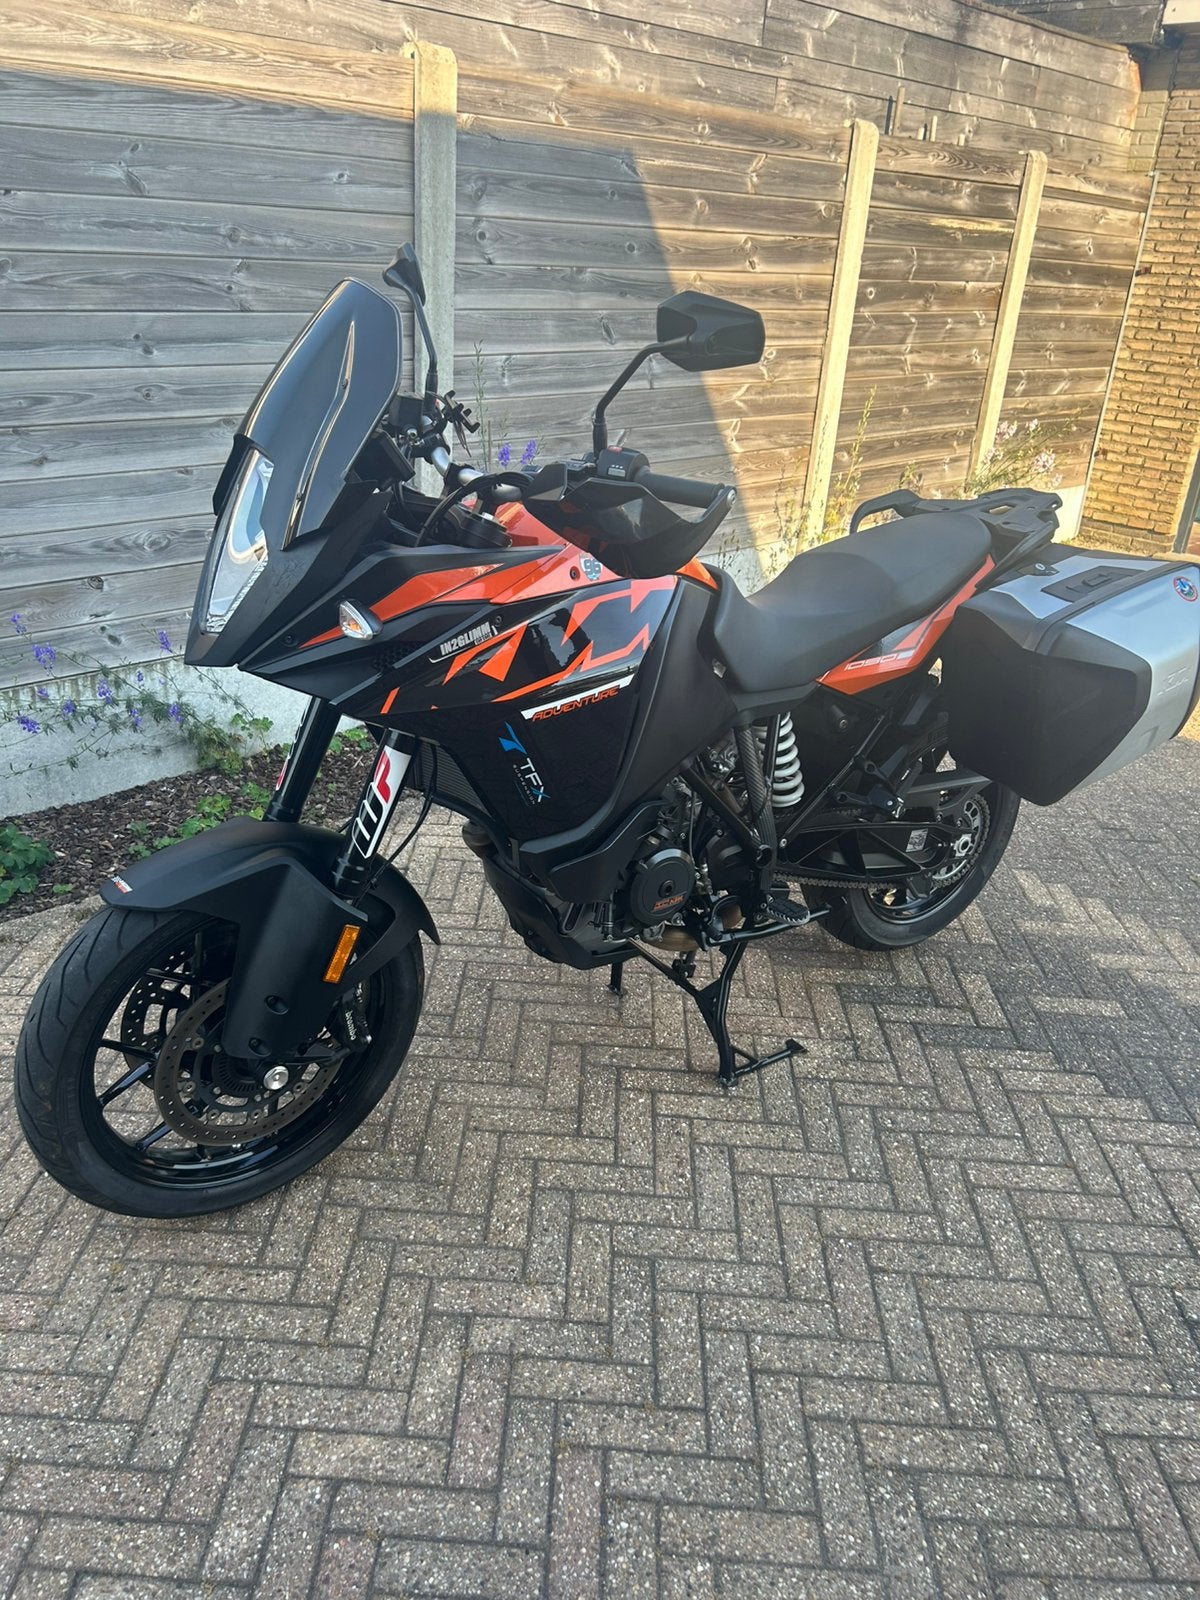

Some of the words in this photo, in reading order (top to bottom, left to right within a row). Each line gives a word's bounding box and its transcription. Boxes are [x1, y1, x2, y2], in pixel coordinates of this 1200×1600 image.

[532, 686, 619, 722] ADVENTURE
[520, 757, 551, 803] TFX
[345, 1010, 357, 1041] brembo
